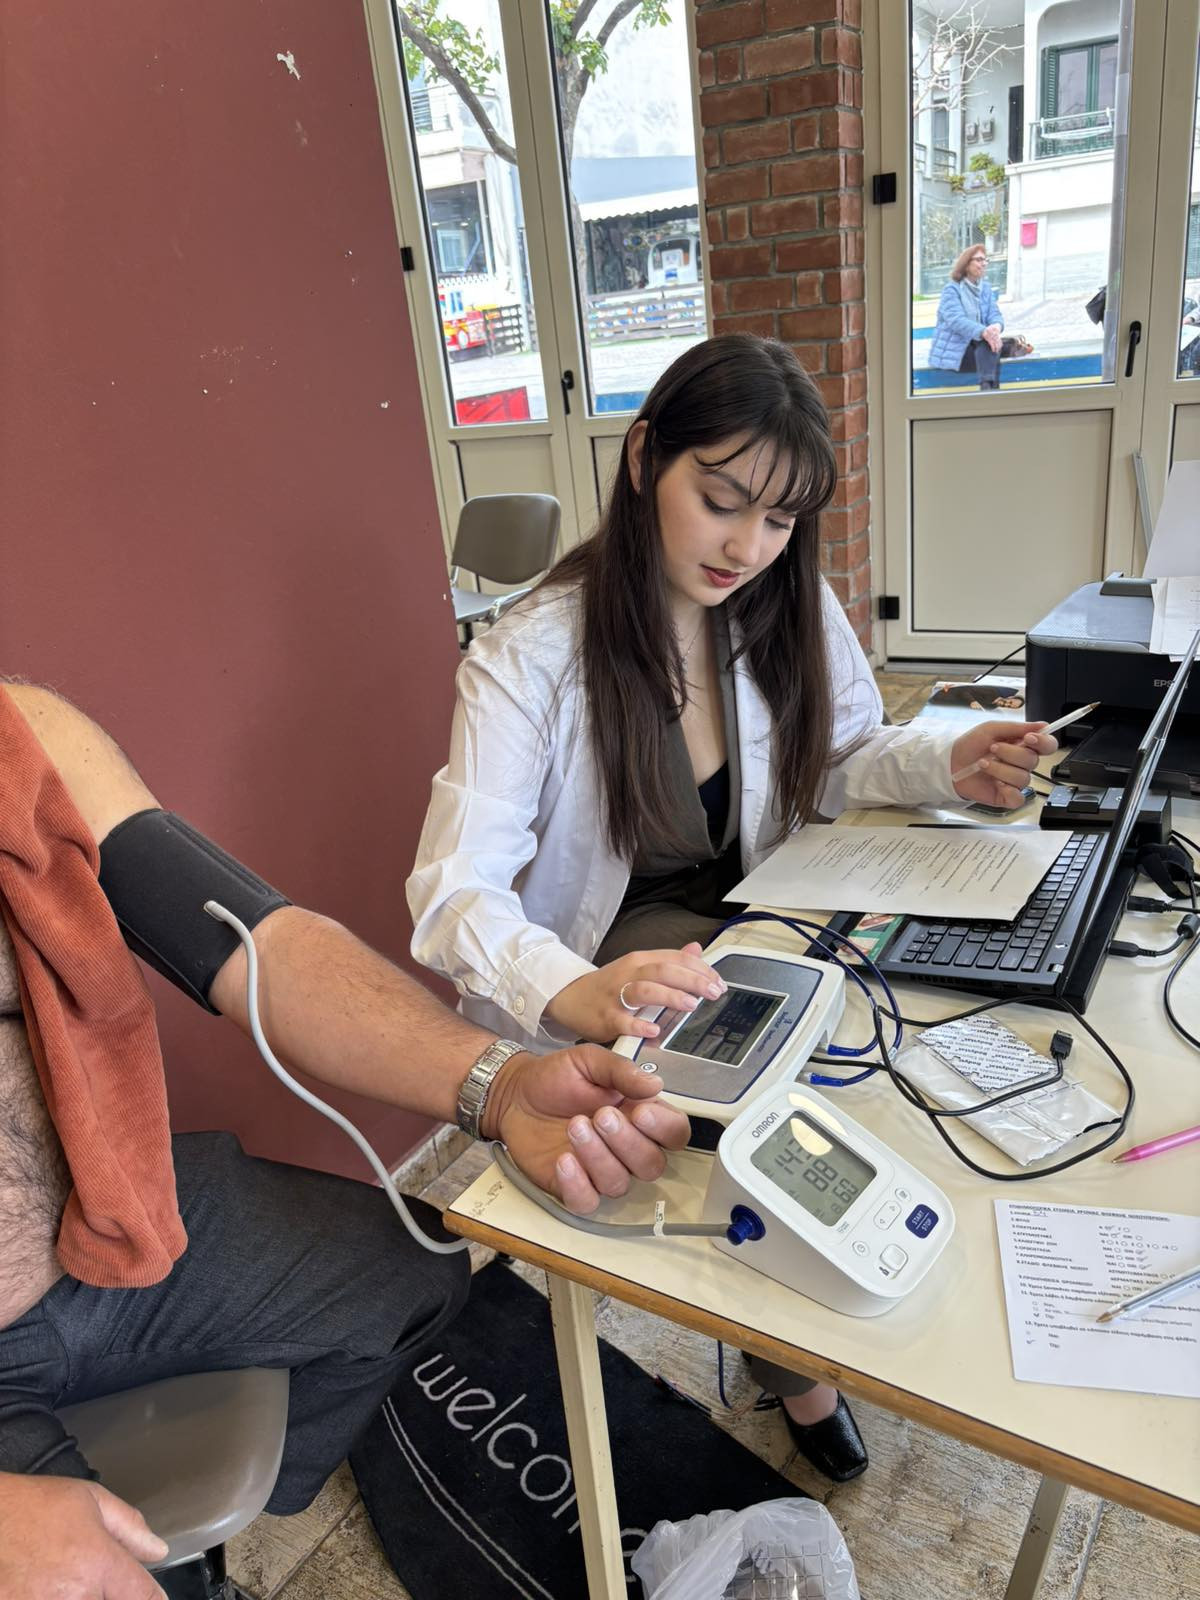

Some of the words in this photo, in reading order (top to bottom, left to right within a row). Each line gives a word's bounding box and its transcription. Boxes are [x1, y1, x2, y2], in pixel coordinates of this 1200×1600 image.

[751, 1111, 780, 1138] OMRON
[803, 1158, 838, 1192] 88
[911, 1209, 925, 1225] START
[921, 1218, 932, 1232] STOP
